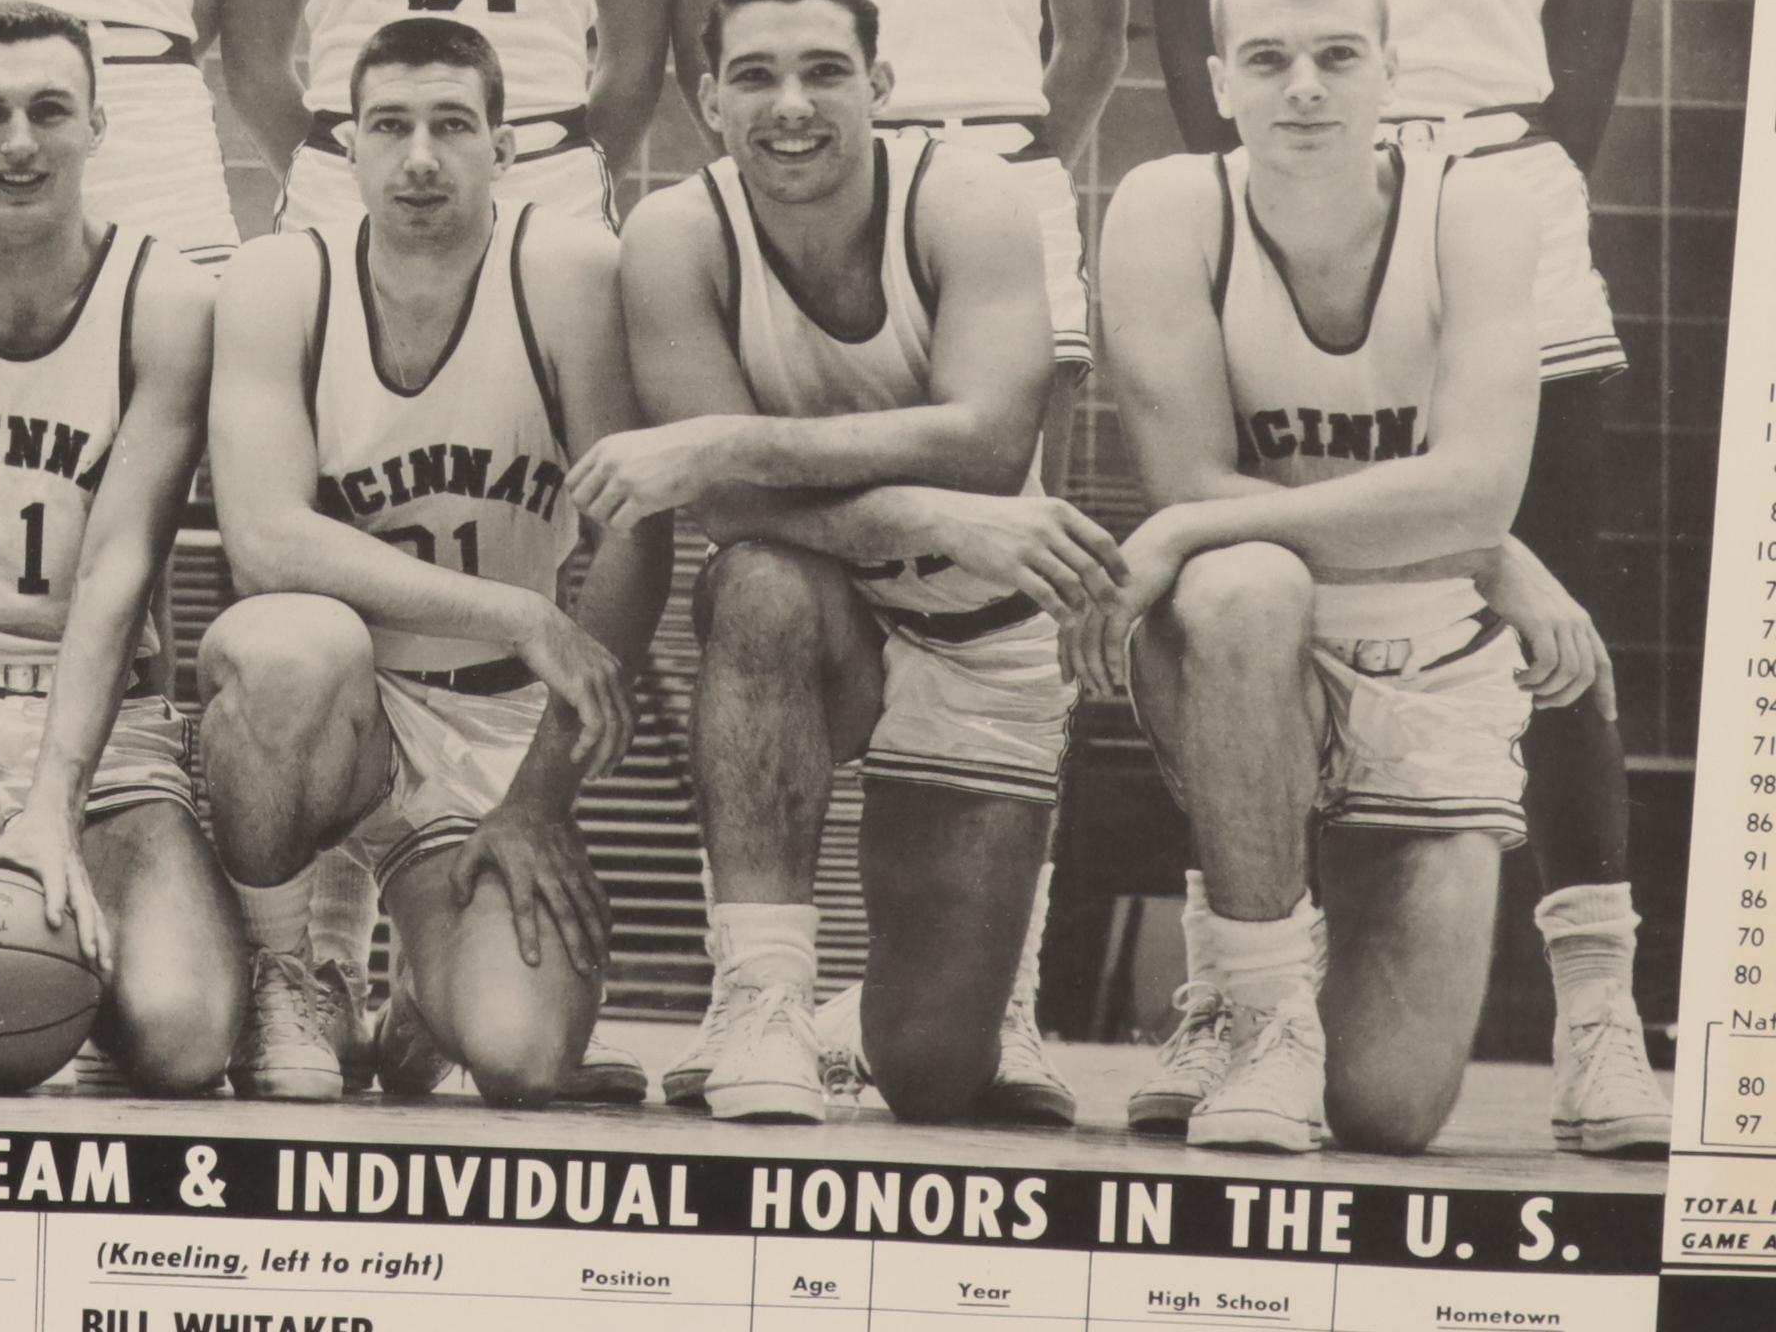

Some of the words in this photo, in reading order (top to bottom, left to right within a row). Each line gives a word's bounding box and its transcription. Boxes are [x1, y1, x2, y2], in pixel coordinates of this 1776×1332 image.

[1750, 774, 1776, 794] 98
[1747, 813, 1773, 832] 86
[1744, 851, 1766, 870] 91
[1741, 889, 1767, 909] 86
[1738, 927, 1764, 947] 70
[1735, 965, 1761, 985] 80
[1738, 1076, 1765, 1096] 80
[1736, 1114, 1762, 1134] 97
[180, 1145, 226, 1207] &
[277, 1149, 699, 1226] INDIVIDUAL
[750, 1167, 1047, 1239] HONORS
[1099, 1182, 1172, 1244] IN
[1226, 1185, 1353, 1253] THE
[1685, 1198, 1757, 1214] TOTAL
[1682, 1233, 1749, 1249] GAME
[98, 1242, 248, 1274] (Kneeling,
[261, 1249, 310, 1272] left
[322, 1252, 349, 1273] to
[362, 1252, 443, 1280] right)
[582, 1269, 670, 1287] Position
[793, 1276, 836, 1295] Age
[959, 1283, 1011, 1299] Year
[1148, 1291, 1200, 1311] High
[1217, 1293, 1290, 1312] School
[1436, 1306, 1560, 1324] Hometown
